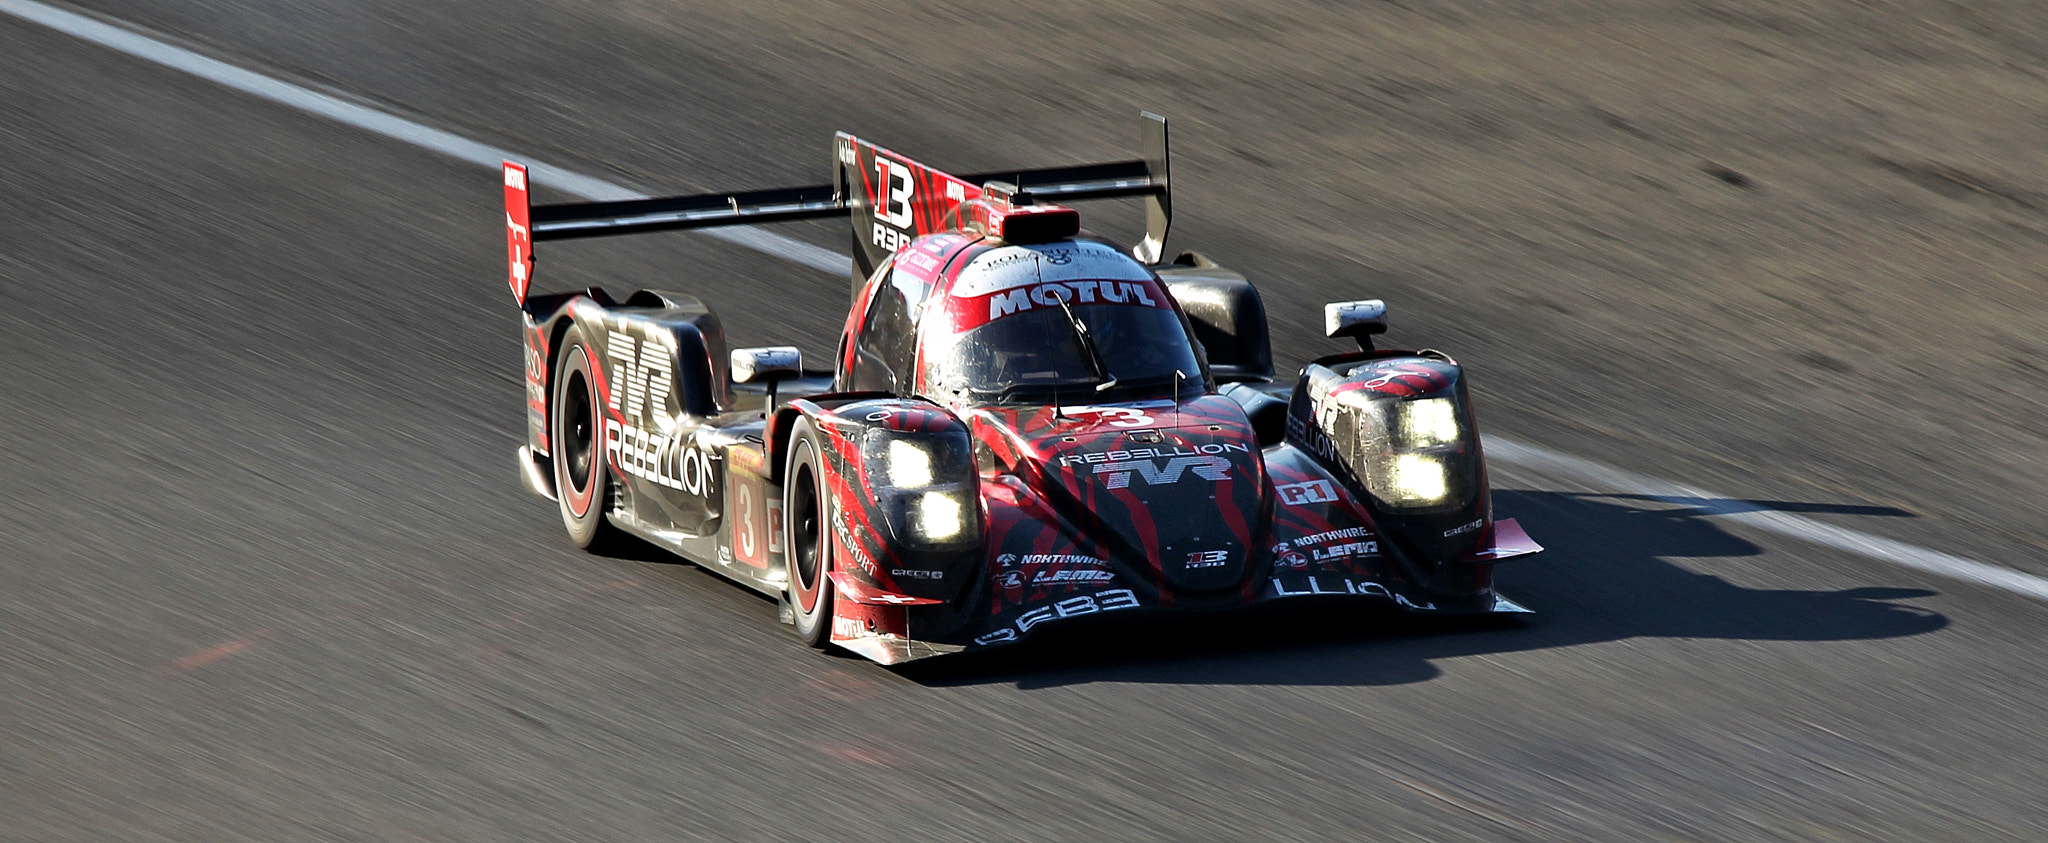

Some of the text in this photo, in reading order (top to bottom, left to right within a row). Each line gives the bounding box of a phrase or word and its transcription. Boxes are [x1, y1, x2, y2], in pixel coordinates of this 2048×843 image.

[504, 166, 525, 191] MOTUL
[990, 280, 1155, 321] MOTUL
[607, 330, 672, 418] TVR
[1102, 408, 1155, 428] 3
[606, 418, 714, 499] REBELLION
[1058, 443, 1250, 467] REBELLION
[1092, 455, 1232, 490] TVR
[1282, 483, 1327, 502] P1
[740, 484, 755, 558] 3
[1293, 526, 1374, 547] NORTHWIRE
[846, 533, 878, 577] SPORT
[1021, 554, 1112, 569] NORTHWIRE
